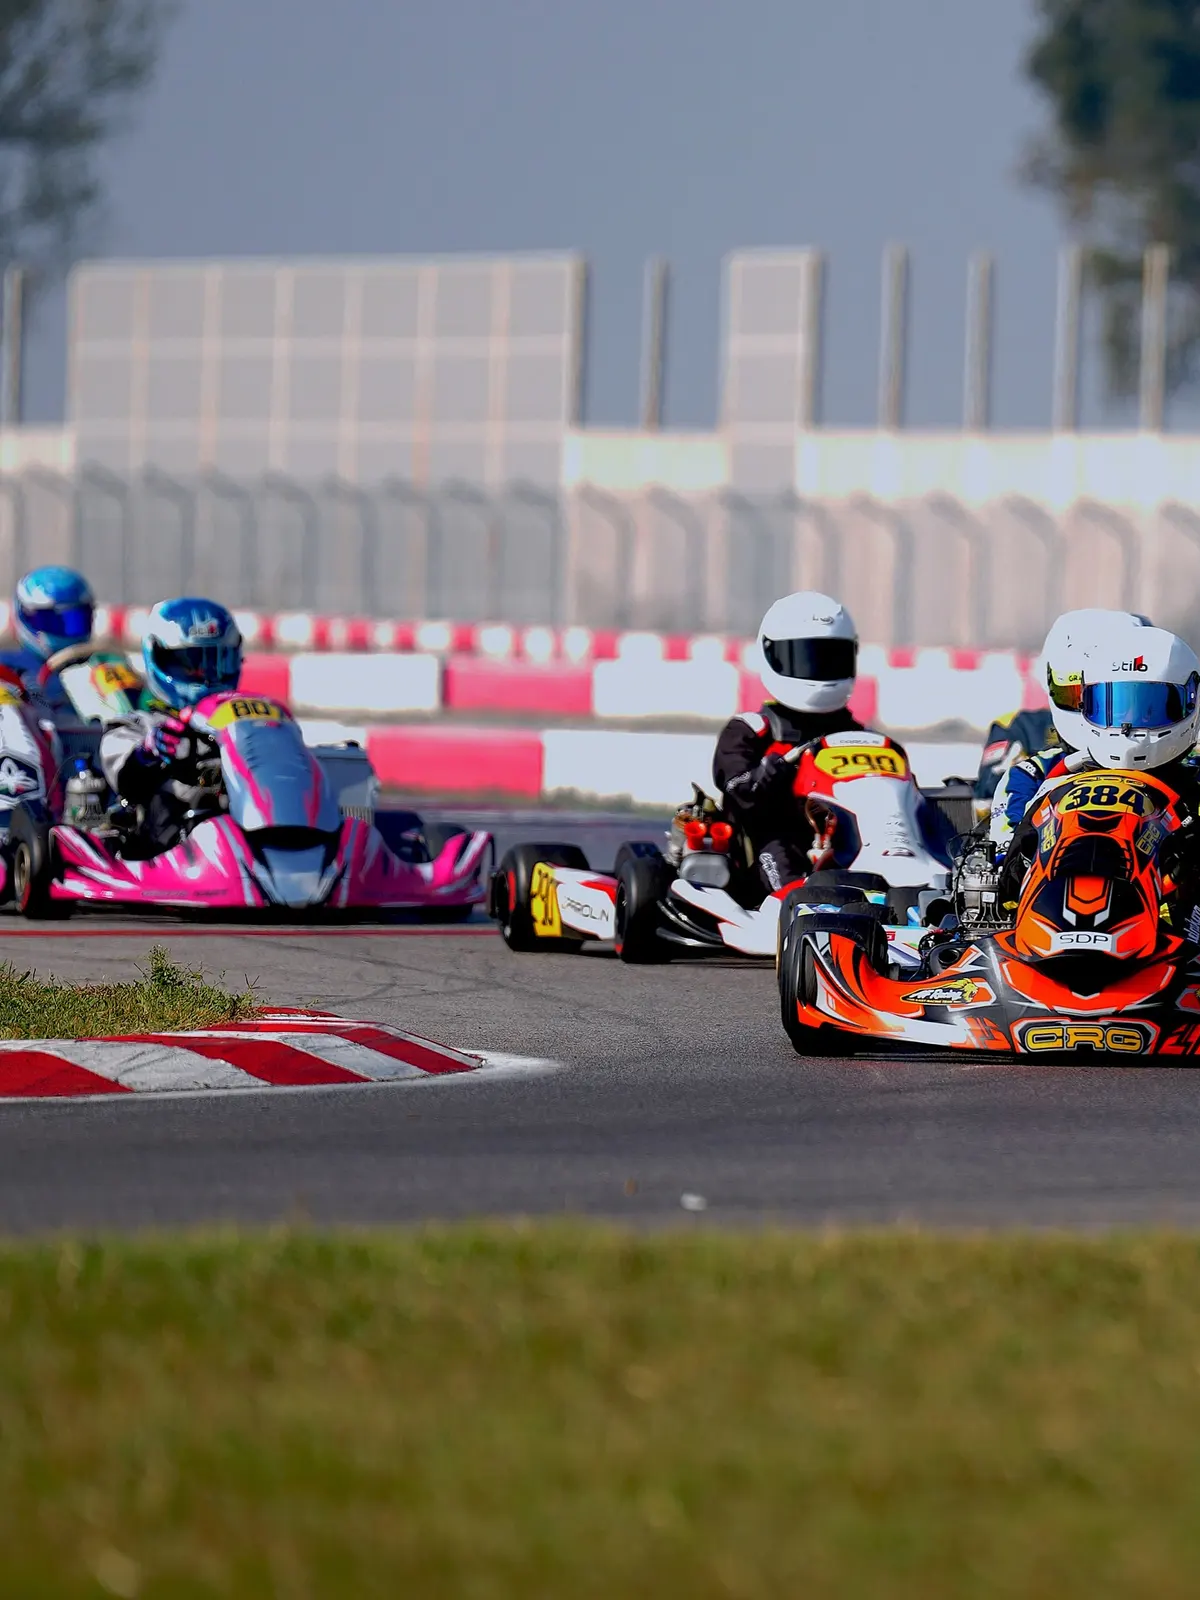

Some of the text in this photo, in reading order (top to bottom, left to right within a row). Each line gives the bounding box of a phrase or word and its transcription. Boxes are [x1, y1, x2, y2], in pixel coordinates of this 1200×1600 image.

[831, 753, 899, 775] 290
[1065, 785, 1145, 817] 384
[1059, 933, 1109, 945] SDP
[1025, 1025, 1145, 1054] CRG
